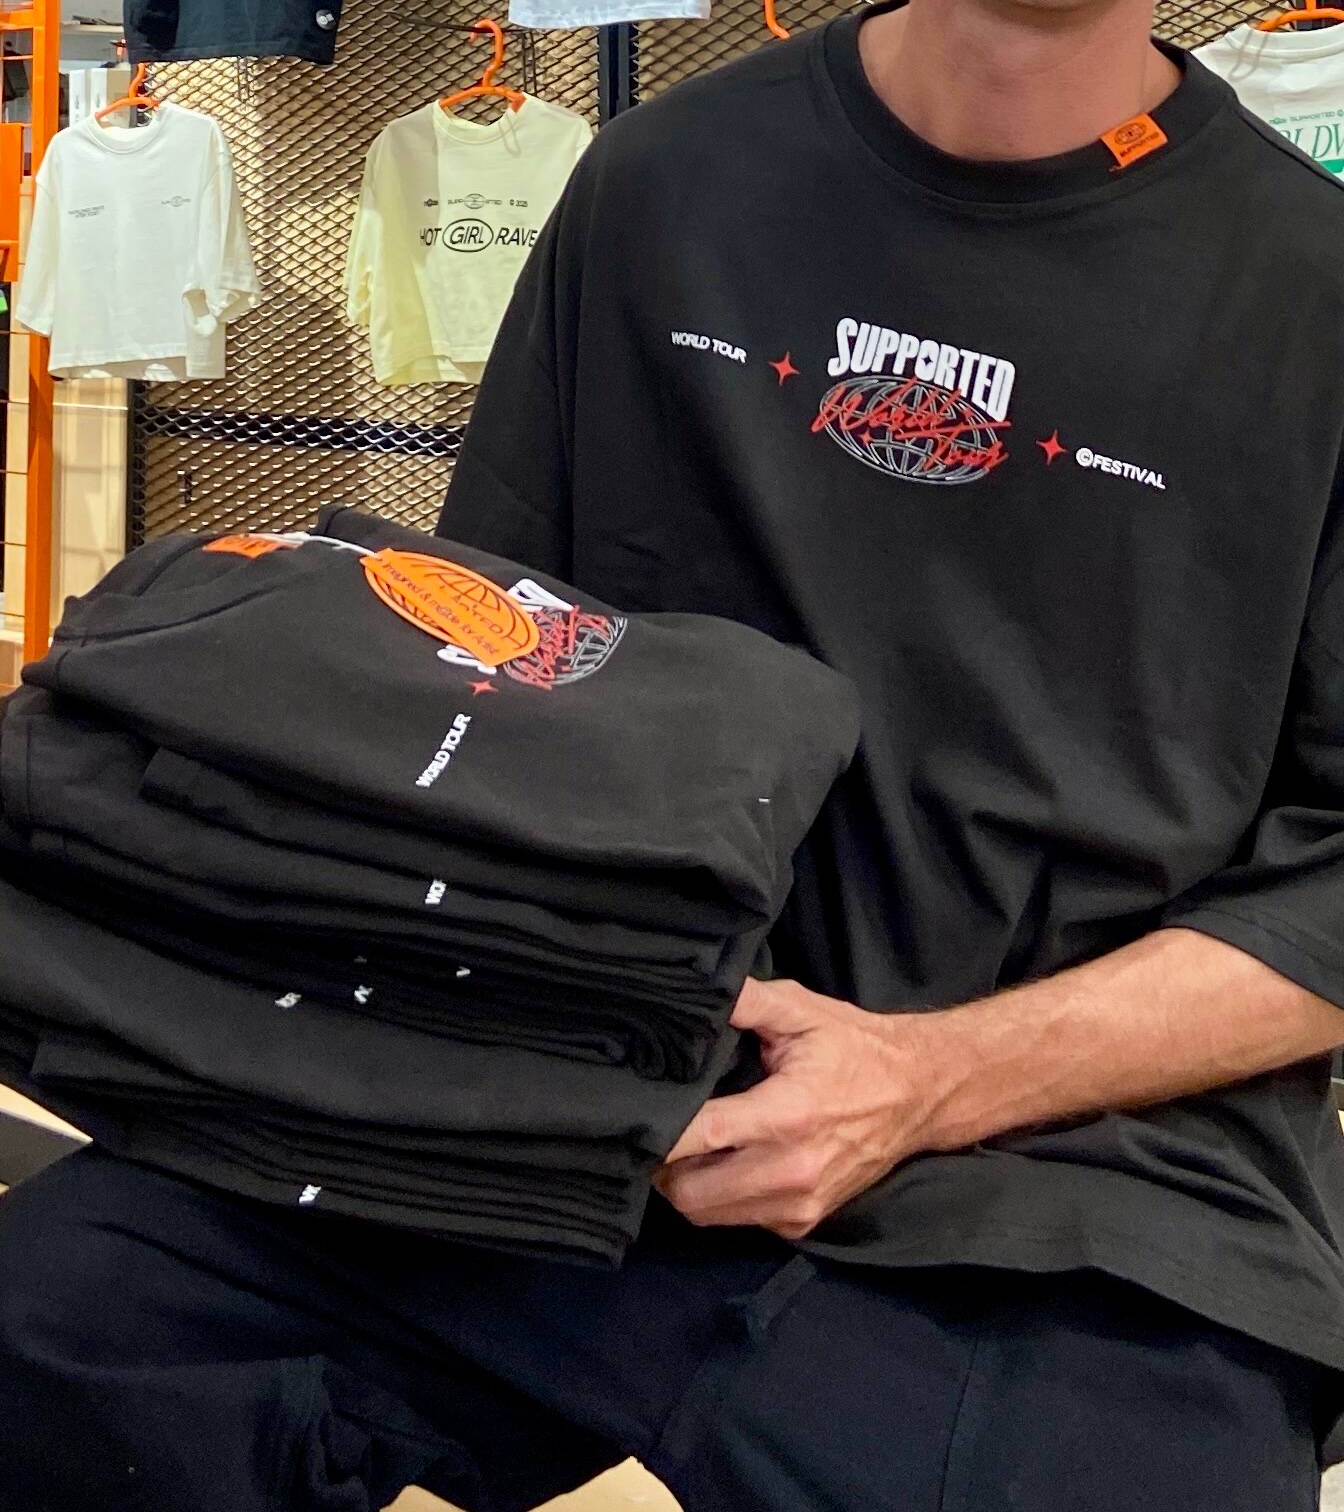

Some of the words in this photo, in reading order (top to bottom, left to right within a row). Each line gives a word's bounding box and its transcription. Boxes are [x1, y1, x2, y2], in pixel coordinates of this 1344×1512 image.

[449, 226, 484, 245] GIRL
[494, 227, 539, 248] RAVE
[671, 331, 711, 350] WORLD
[712, 338, 747, 364] TOUR
[827, 317, 1016, 423] SUPPORTED
[415, 749, 451, 788] WORLD
[440, 713, 472, 752] TOUR
